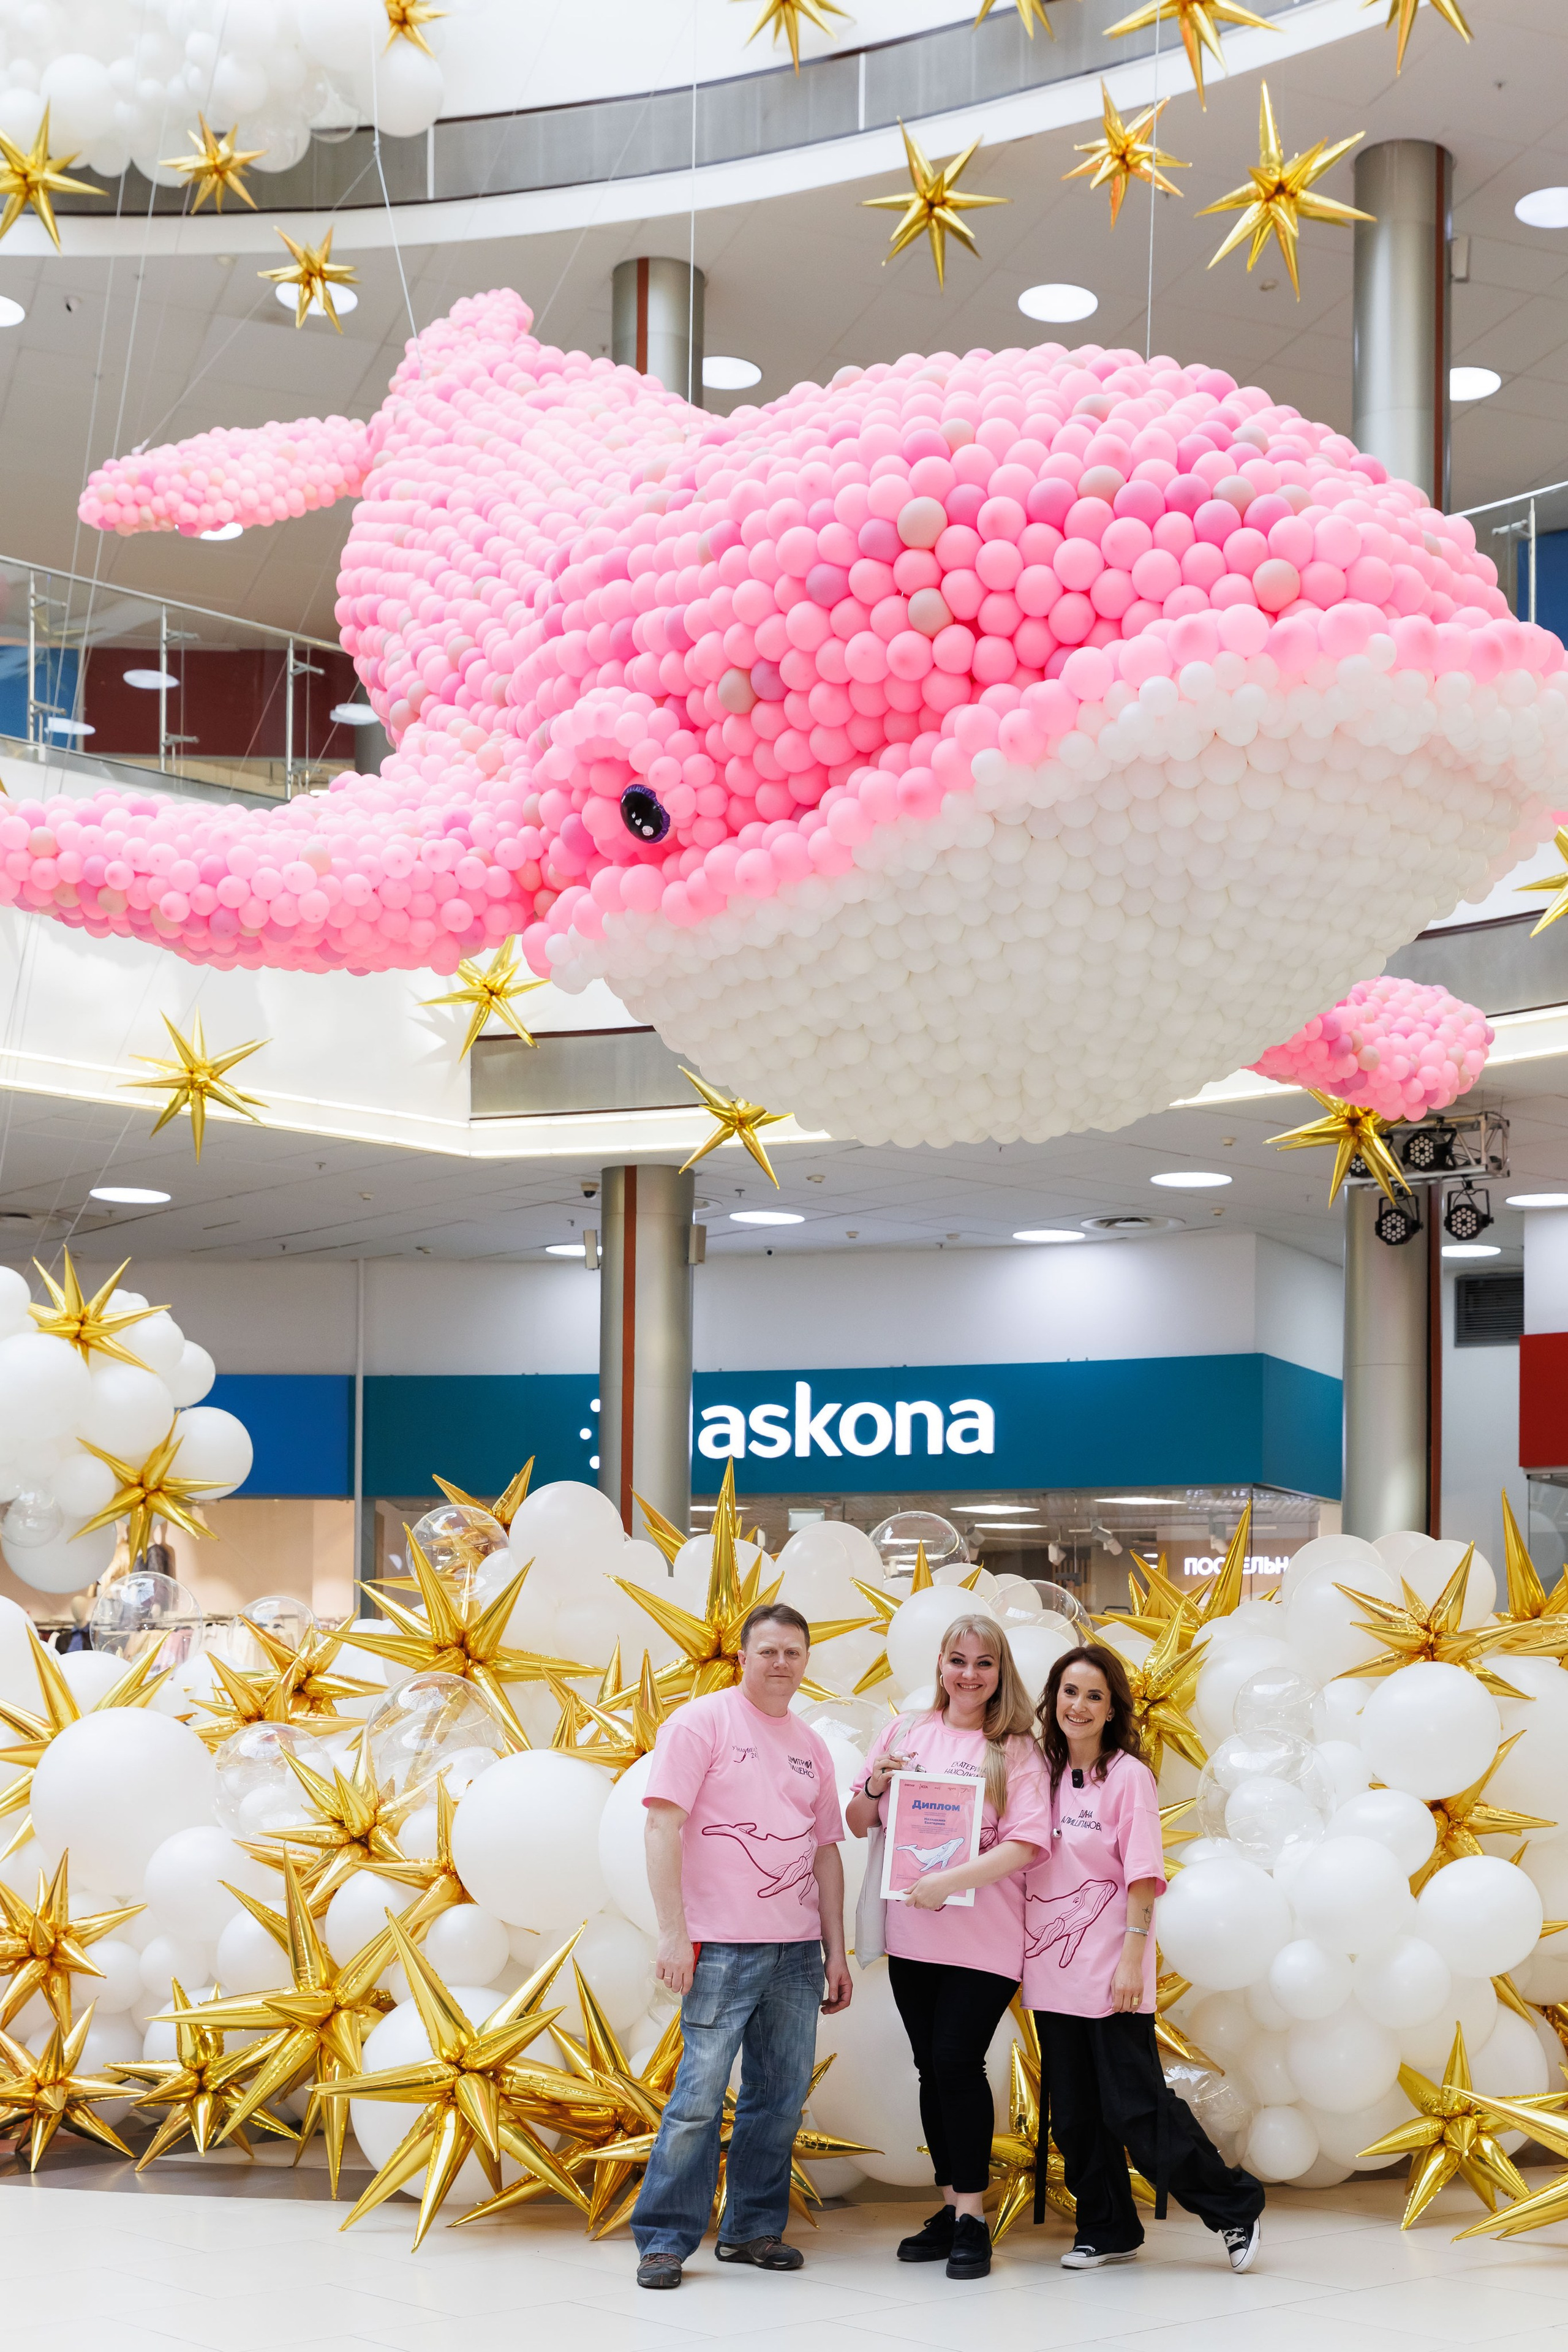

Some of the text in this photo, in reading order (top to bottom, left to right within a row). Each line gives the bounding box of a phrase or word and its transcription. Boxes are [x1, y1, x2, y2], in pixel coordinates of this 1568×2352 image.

[698, 1381, 995, 1459] askona
[1184, 1556, 1291, 1575] ПОСЕЛЬН
[912, 1800, 960, 1812] Диплом
[1078, 1809, 1093, 1819] ДИНА
[1061, 1815, 1102, 1832] АЛИШПАНОВ
